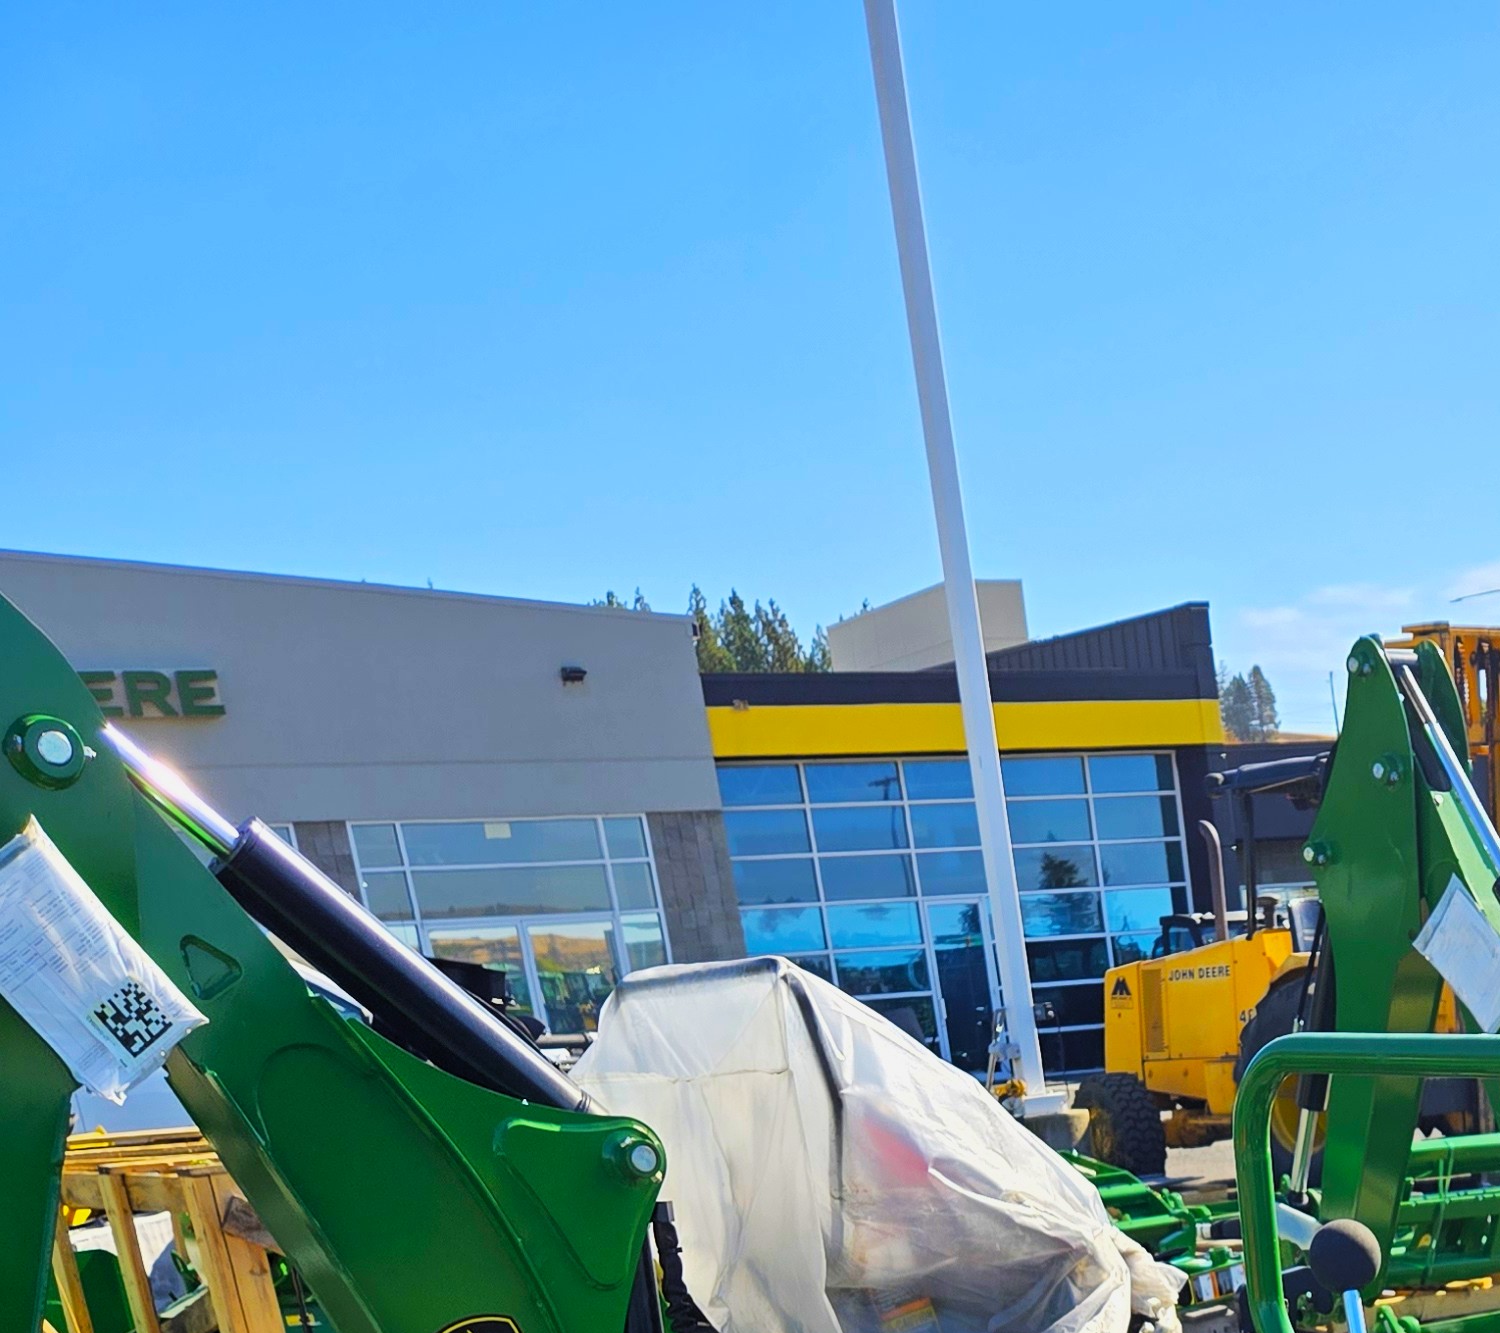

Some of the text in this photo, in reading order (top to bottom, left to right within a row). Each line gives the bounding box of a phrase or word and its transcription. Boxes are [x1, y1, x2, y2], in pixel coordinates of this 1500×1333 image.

[77, 670, 227, 717] ERE
[1168, 965, 1231, 982] JOHN DEERE
